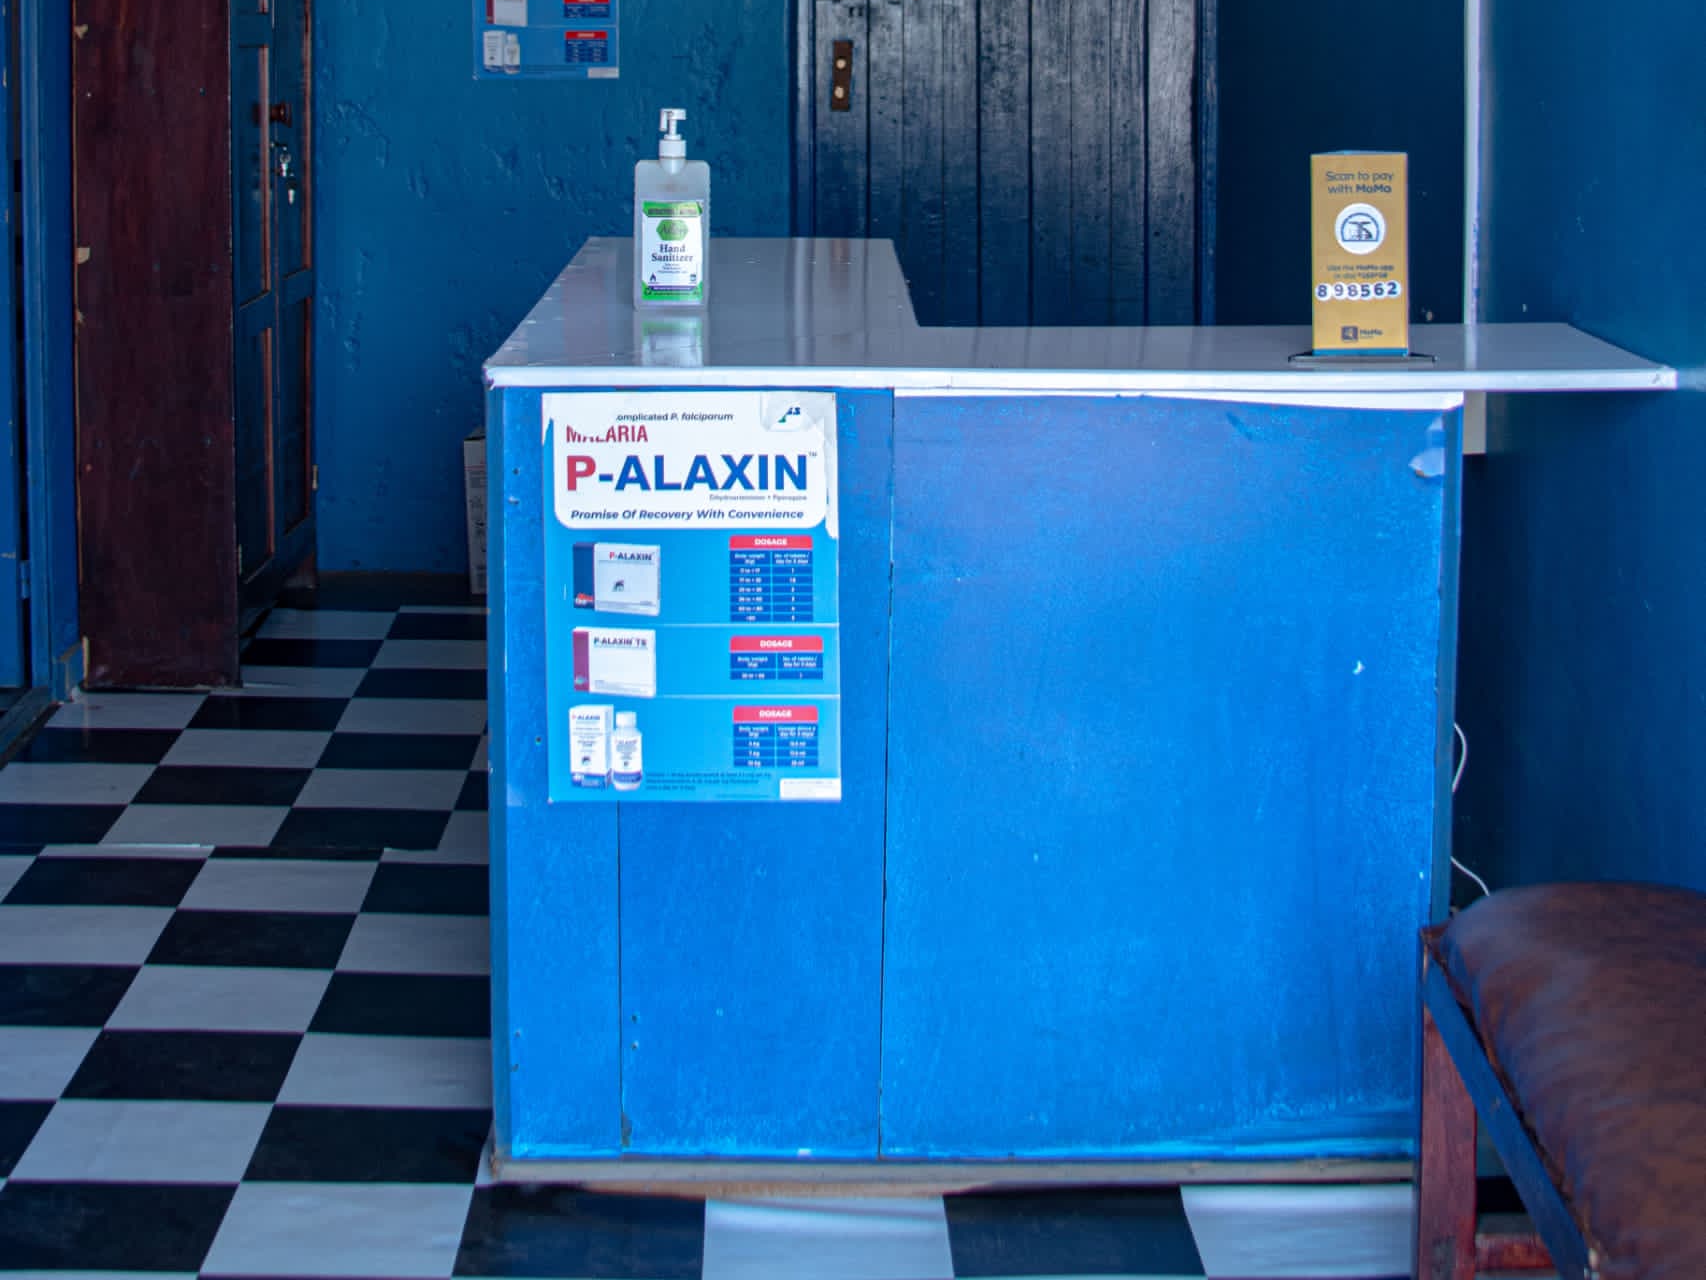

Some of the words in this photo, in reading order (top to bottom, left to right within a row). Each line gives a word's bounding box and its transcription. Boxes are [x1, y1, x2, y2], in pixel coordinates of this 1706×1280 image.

[1326, 170, 1355, 181] Scan
[1358, 170, 1370, 181] to
[1372, 171, 1394, 183] pay
[1327, 182, 1353, 193] with
[1355, 183, 1393, 193] MoMo
[659, 243, 686, 253] Hand
[651, 252, 694, 262] Sanitizer
[1316, 281, 1398, 298] 898562
[616, 412, 668, 422] omplicated
[681, 411, 734, 422] falciparum
[566, 453, 808, 492] P-ALAXIN
[571, 509, 619, 520] Promise
[622, 509, 637, 520] Of
[638, 509, 693, 521] Recovery
[696, 508, 725, 520] With
[728, 509, 805, 520] Convenience
[754, 538, 788, 546] DOSAGE
[609, 551, 652, 561] P-ALAXIN
[759, 639, 793, 648] DOSAGE
[759, 709, 792, 718] DOSAGE
